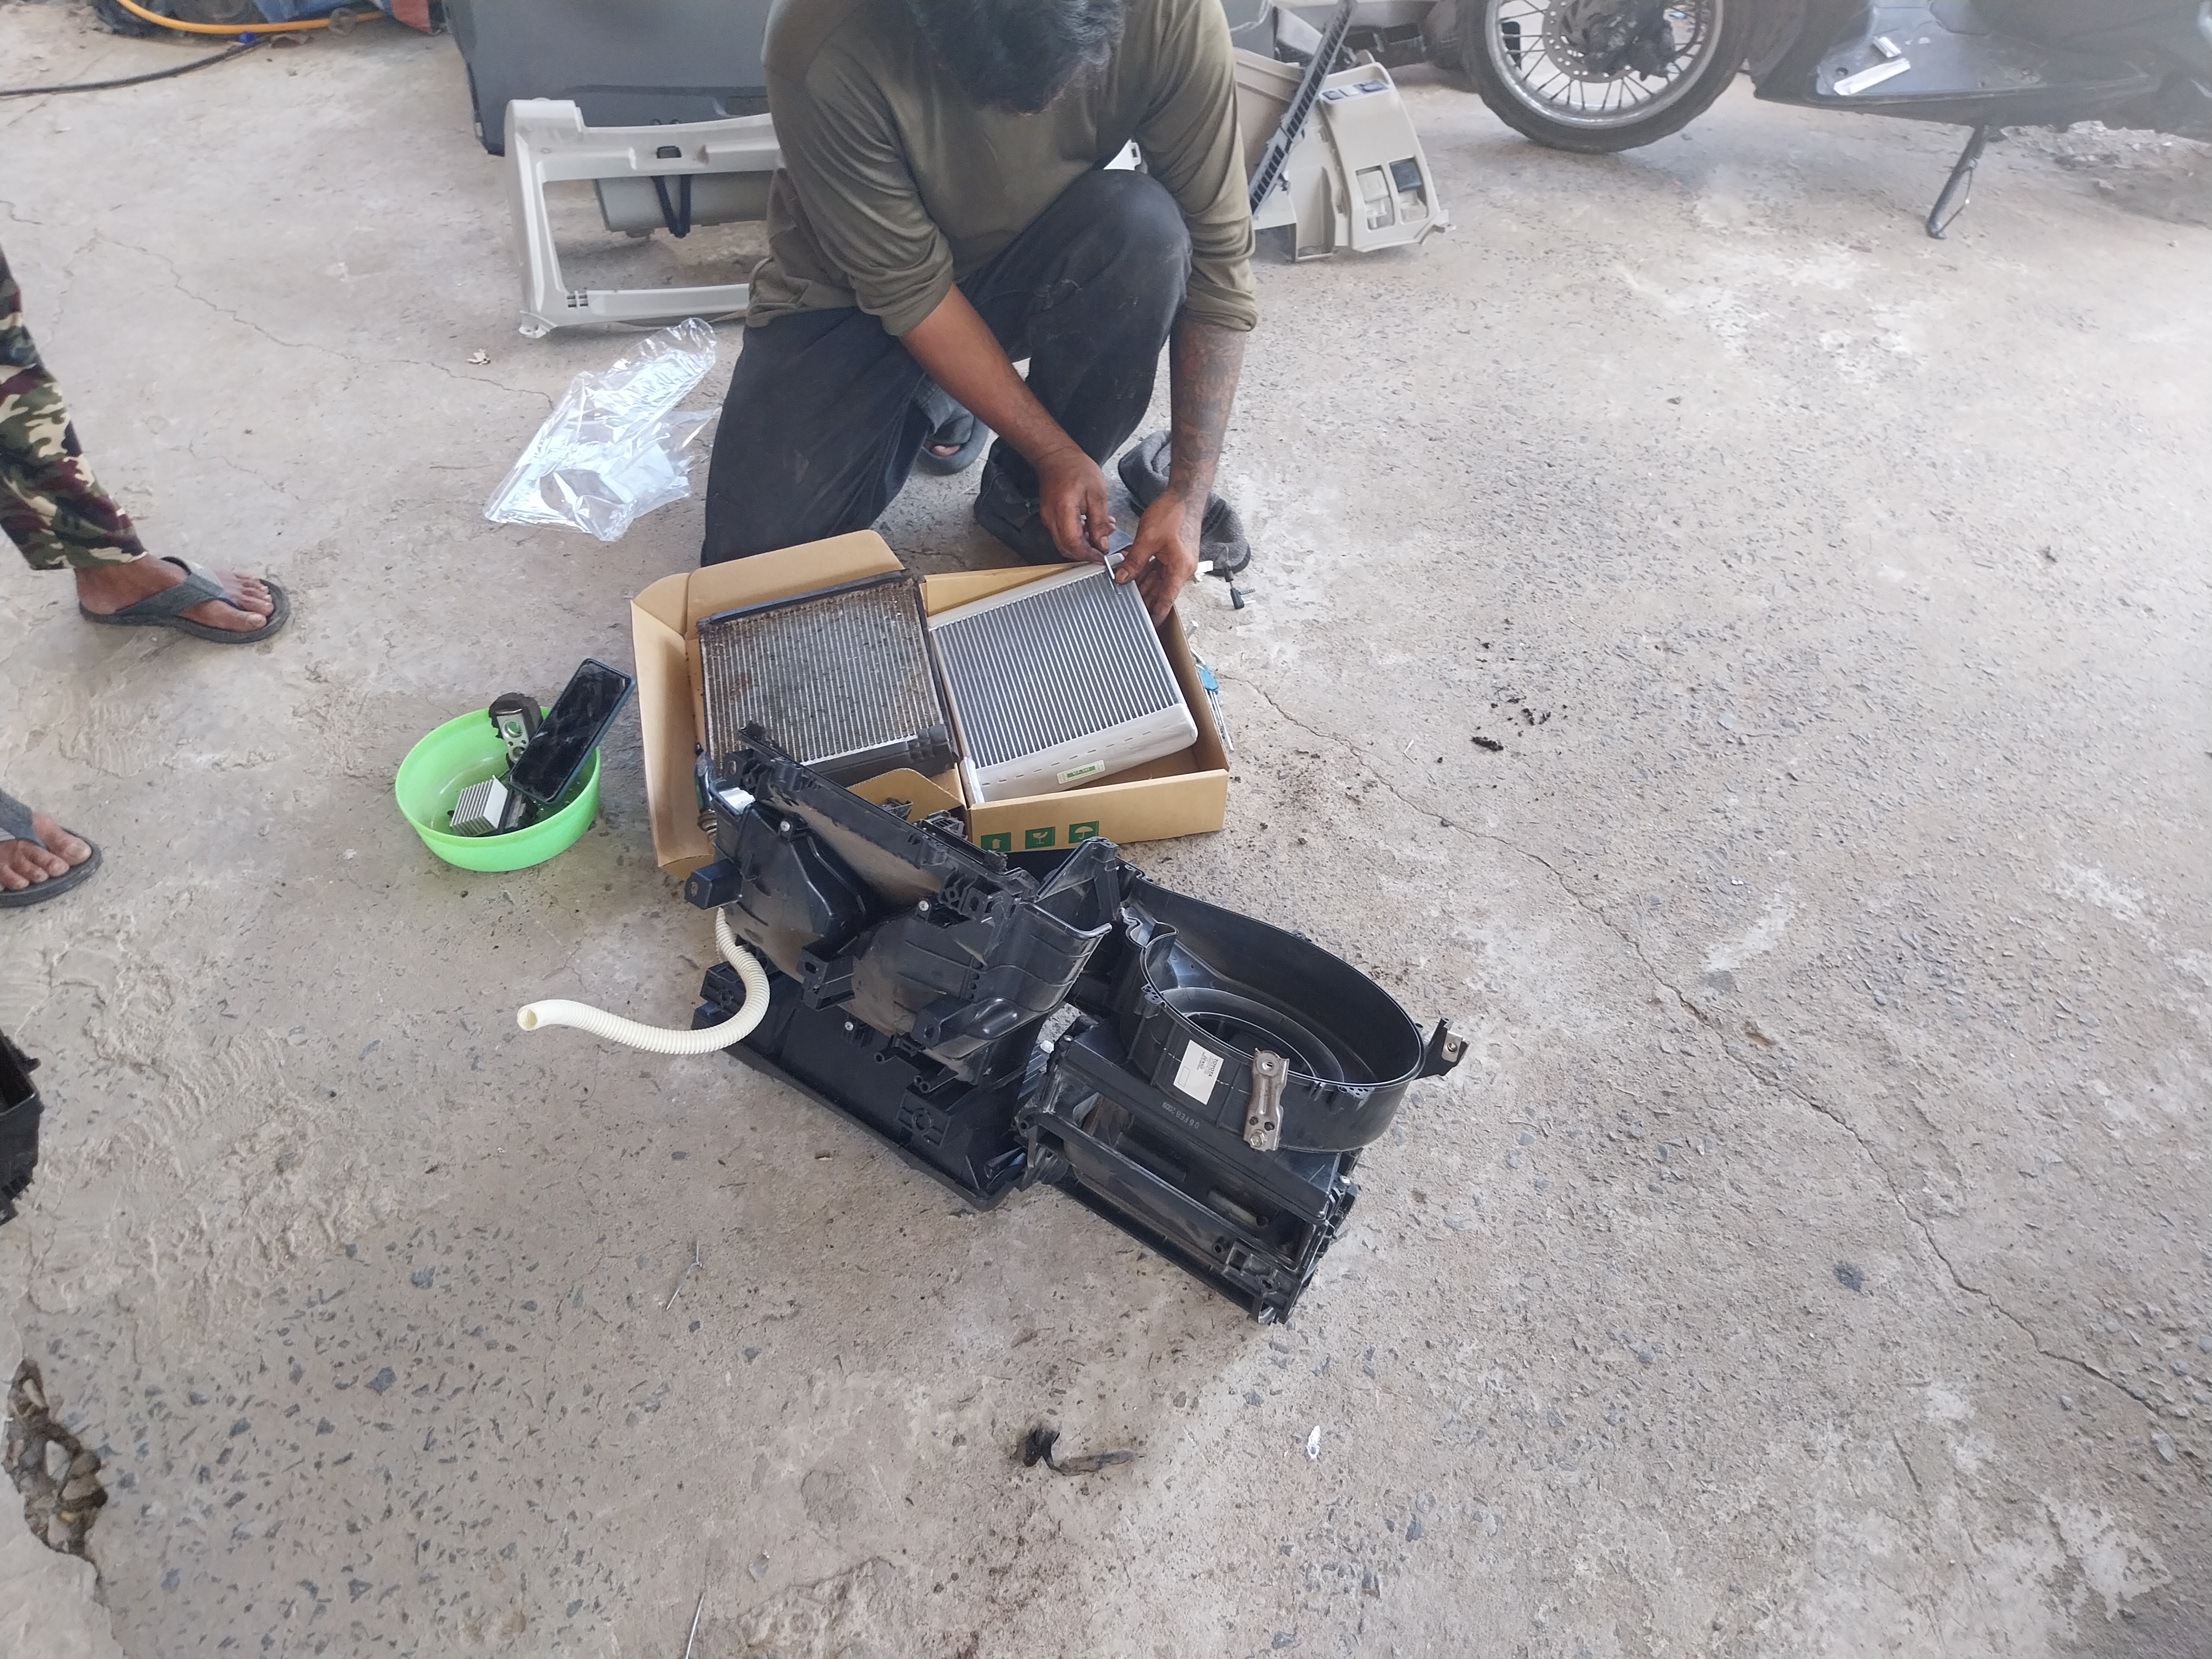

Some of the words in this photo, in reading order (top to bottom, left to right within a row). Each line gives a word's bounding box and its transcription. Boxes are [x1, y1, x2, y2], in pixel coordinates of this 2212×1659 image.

[1208, 1058, 1218, 1077] TOYOTA
[1162, 1102, 1176, 1114] 2009
[1176, 1110, 1189, 1123] FEB
